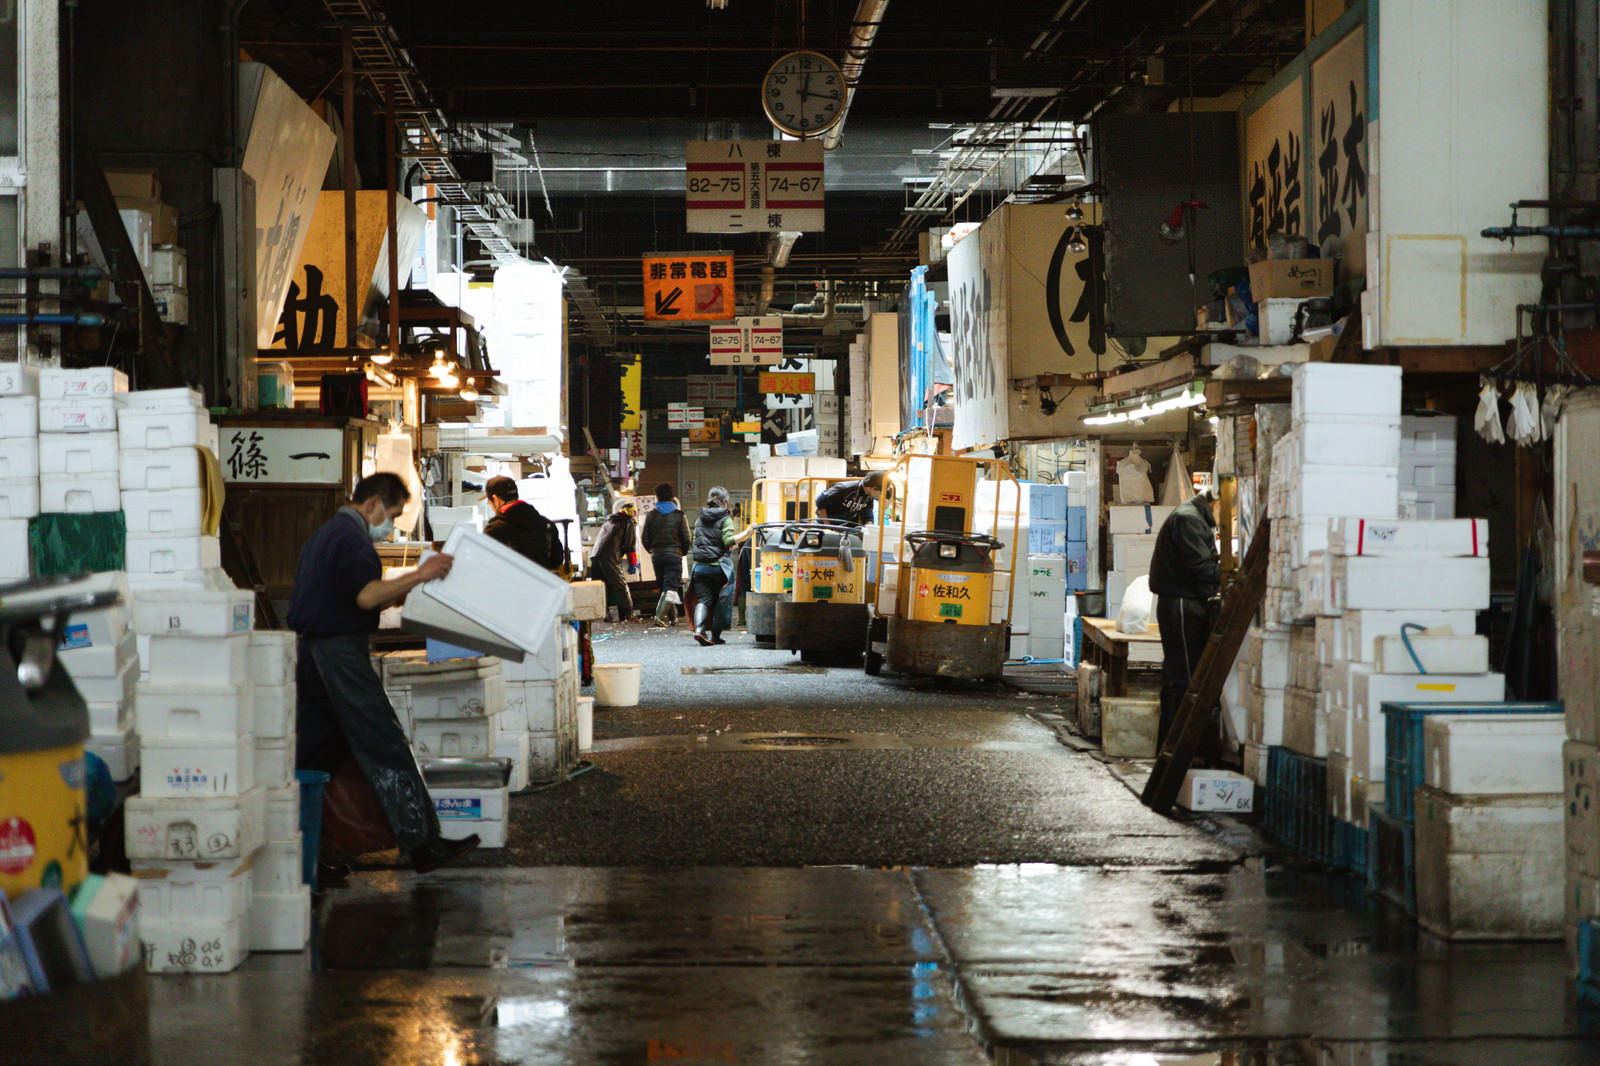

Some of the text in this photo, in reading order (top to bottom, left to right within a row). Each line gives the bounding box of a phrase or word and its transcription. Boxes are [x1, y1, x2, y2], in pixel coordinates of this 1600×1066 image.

[784, 64, 796, 73] 11
[800, 59, 812, 70] 12
[774, 75, 788, 85] 10
[825, 75, 835, 85] 2
[771, 88, 781, 98] 9
[775, 102, 784, 112] 8
[824, 102, 834, 112] 4
[786, 114, 795, 124] 7
[800, 118, 809, 128] 6
[815, 114, 824, 124] 5
[689, 177, 741, 193] 82-75
[769, 177, 821, 193] 74-67
[650, 261, 728, 280] 非常電話
[711, 335, 739, 345] 82-75
[754, 335, 781, 345] 74-67
[227, 431, 331, 480] 篠一
[810, 568, 835, 581] 大仲
[837, 583, 854, 593] No.2
[933, 584, 971, 600] 佐和久
